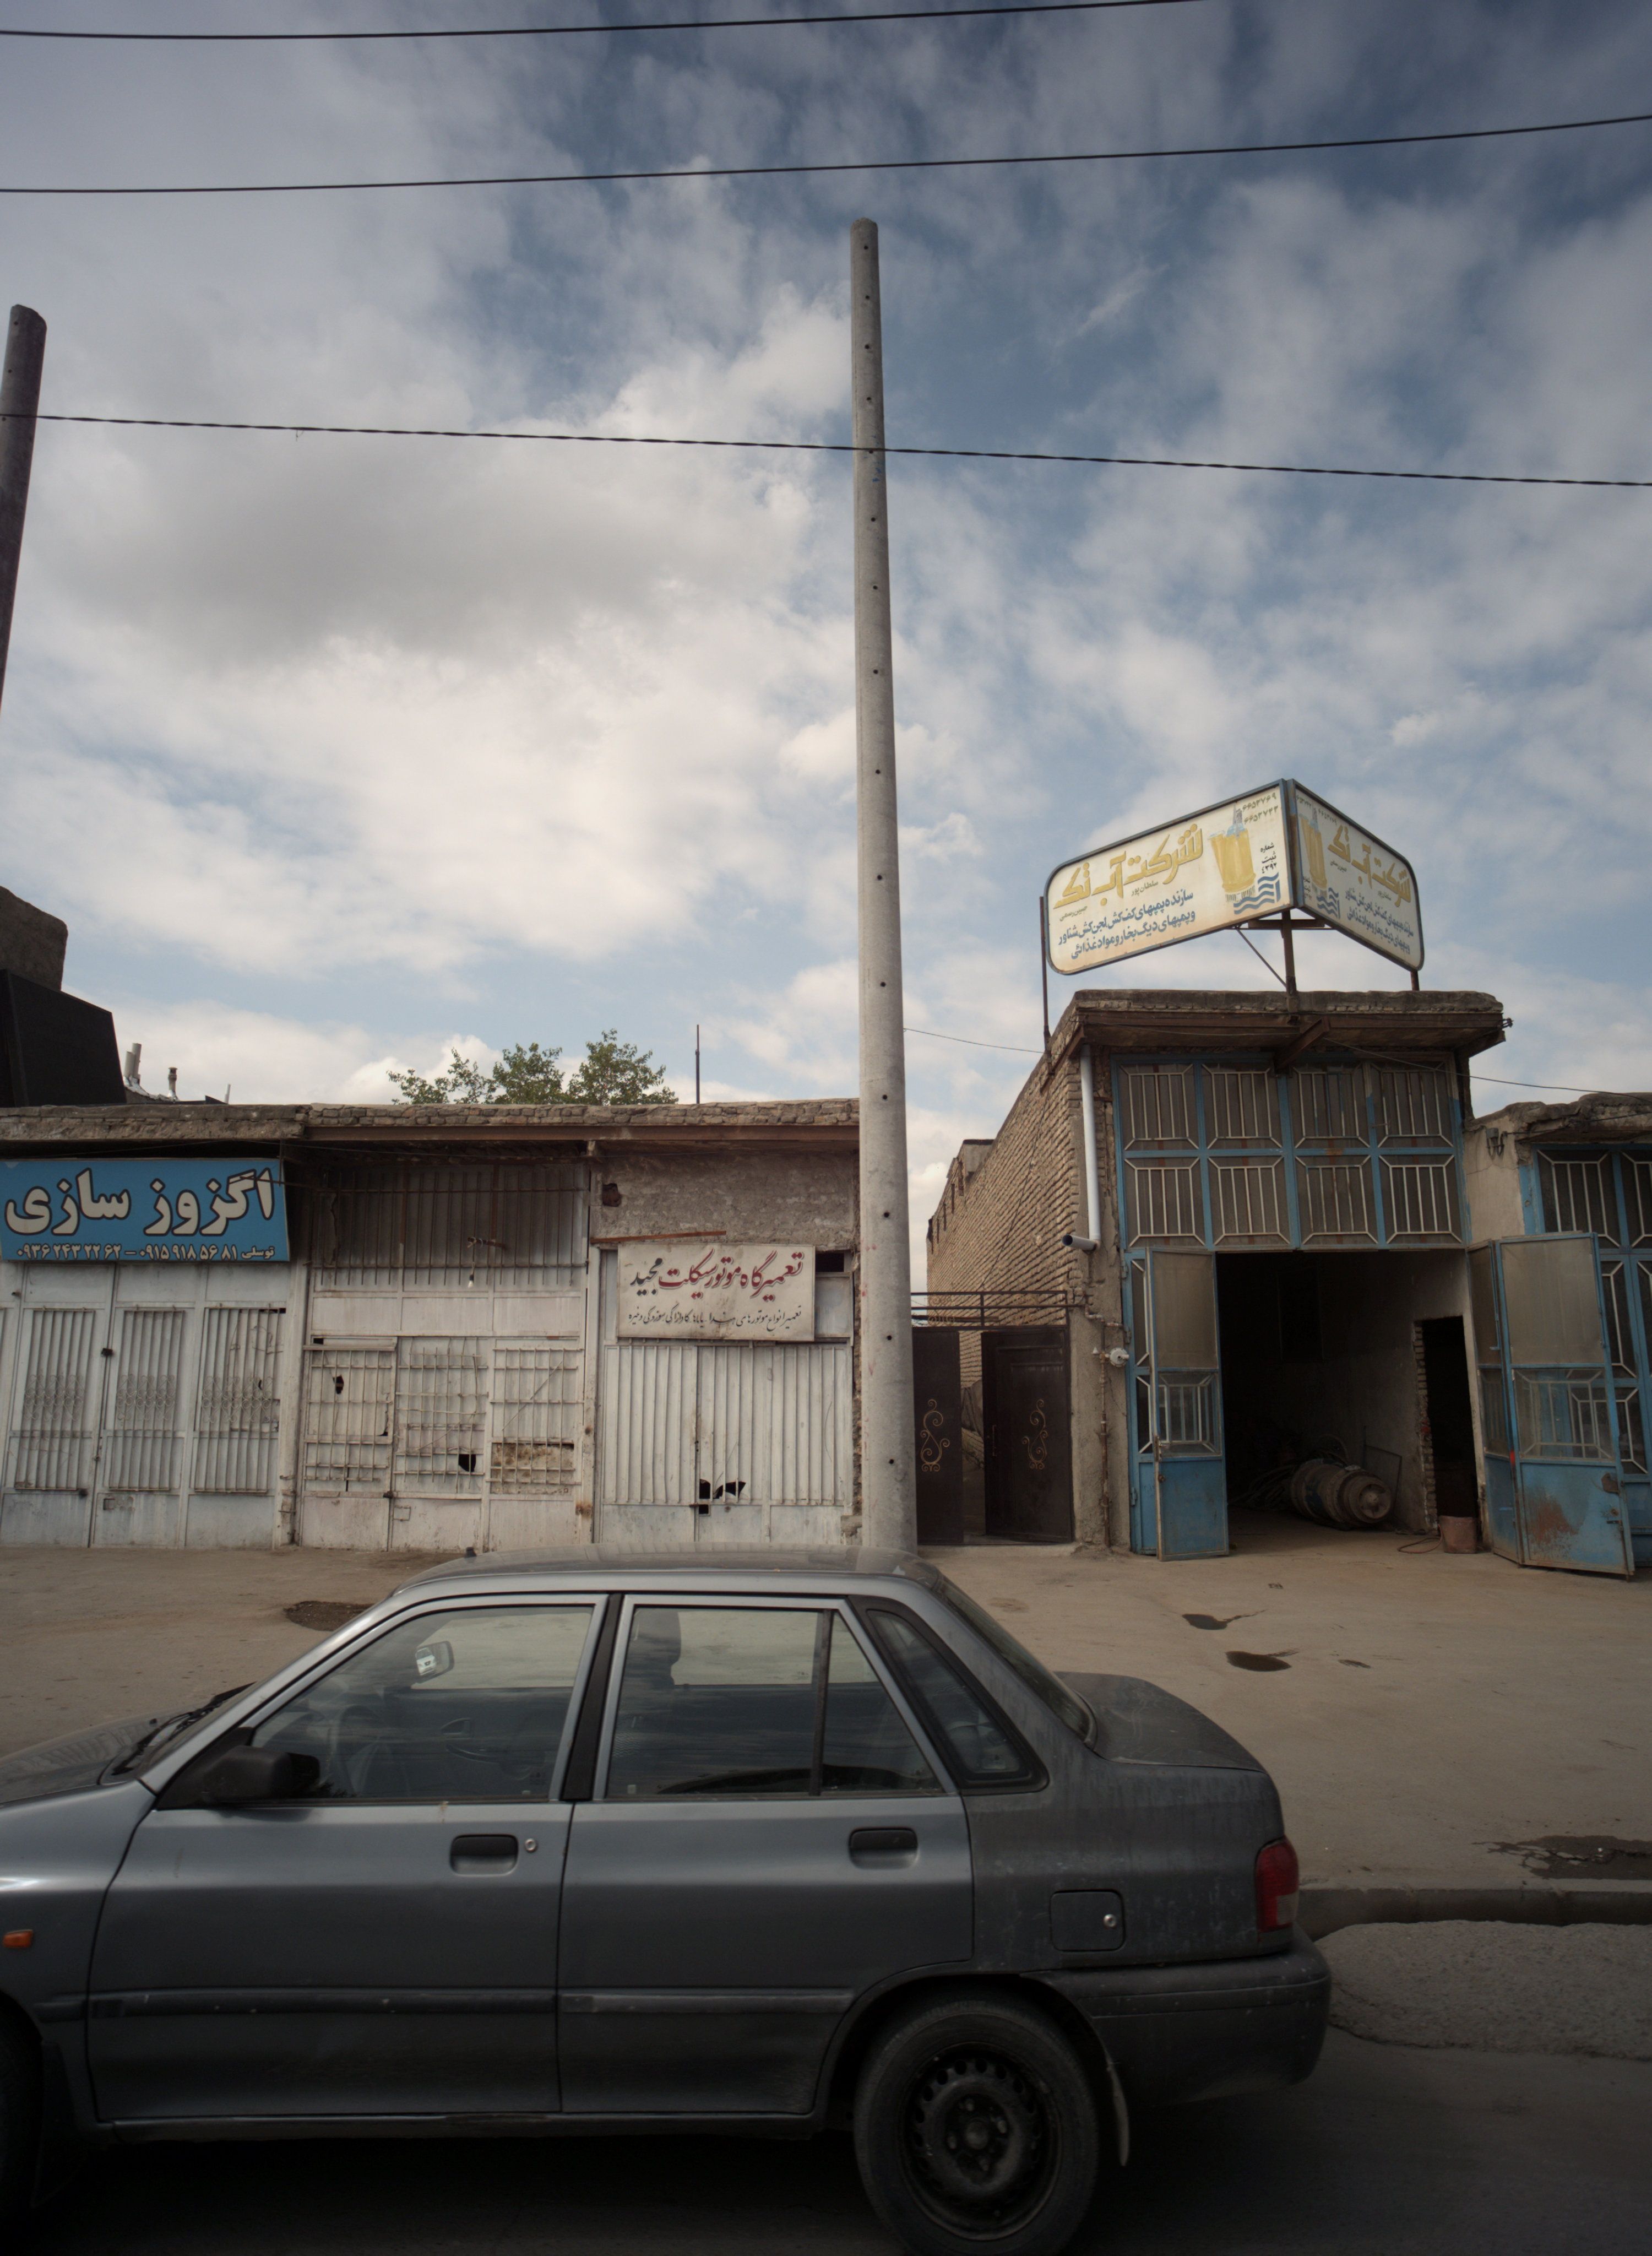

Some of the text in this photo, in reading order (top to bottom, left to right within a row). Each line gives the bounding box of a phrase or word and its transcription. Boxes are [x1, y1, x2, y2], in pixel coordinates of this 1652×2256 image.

[1052, 823, 1204, 909] شرکت آب تک
[1262, 850, 1276, 864] ثبت
[1165, 888, 1194, 907] سازنده
[1058, 925, 1079, 945] شناور
[4, 1167, 275, 1237] اگزوز سازی
[17, 1243, 51, 1260] ۰۹۳۶
[139, 1243, 170, 1260] ۰۹۱۵
[172, 1243, 197, 1261] ۹۱۸
[199, 1243, 219, 1261] ۵۶
[221, 1243, 238, 1261] ۸۱
[241, 1246, 275, 1260] توسلی
[630, 1257, 663, 1296] مجید
[740, 1250, 805, 1302] تعمیرگاه
[780, 1305, 802, 1330] تعمیر
